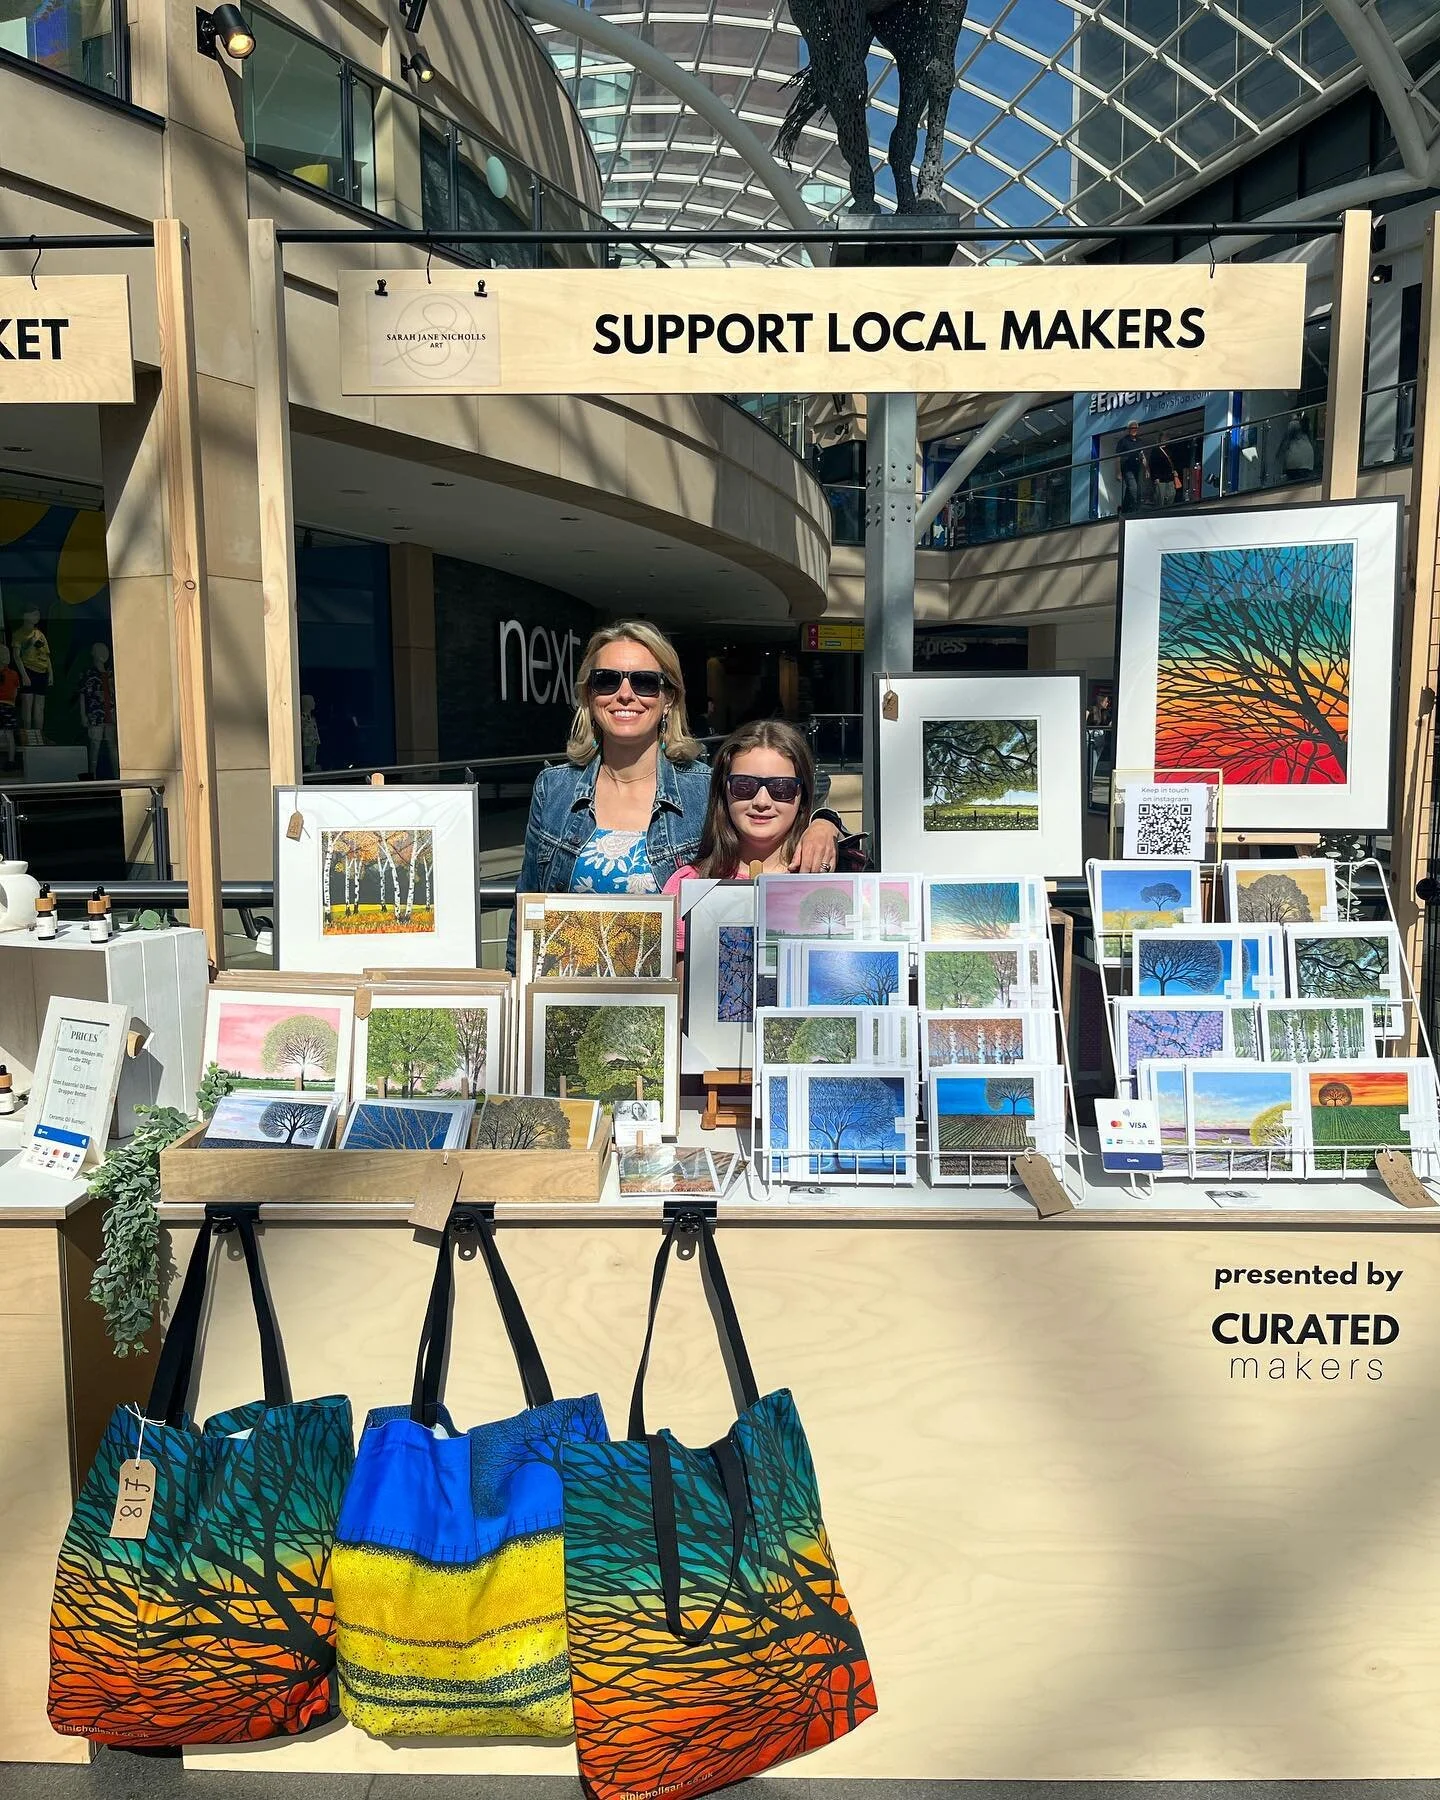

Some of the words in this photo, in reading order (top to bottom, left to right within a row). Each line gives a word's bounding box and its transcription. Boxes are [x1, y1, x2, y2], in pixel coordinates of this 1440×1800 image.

[386, 333, 416, 341] SARAH
[417, 333, 439, 342] JANE
[441, 333, 486, 341] NICHOLLS
[593, 312, 814, 355] SUPPORT
[829, 310, 987, 353] LOCAL
[1000, 307, 1205, 351] MAKERS
[499, 619, 582, 711] next
[70, 1030, 99, 1043] PRICES
[1214, 1261, 1358, 1291] presented
[1368, 1261, 1404, 1292] by
[1211, 1312, 1400, 1346] CURATED
[1229, 1351, 1384, 1381] makers
